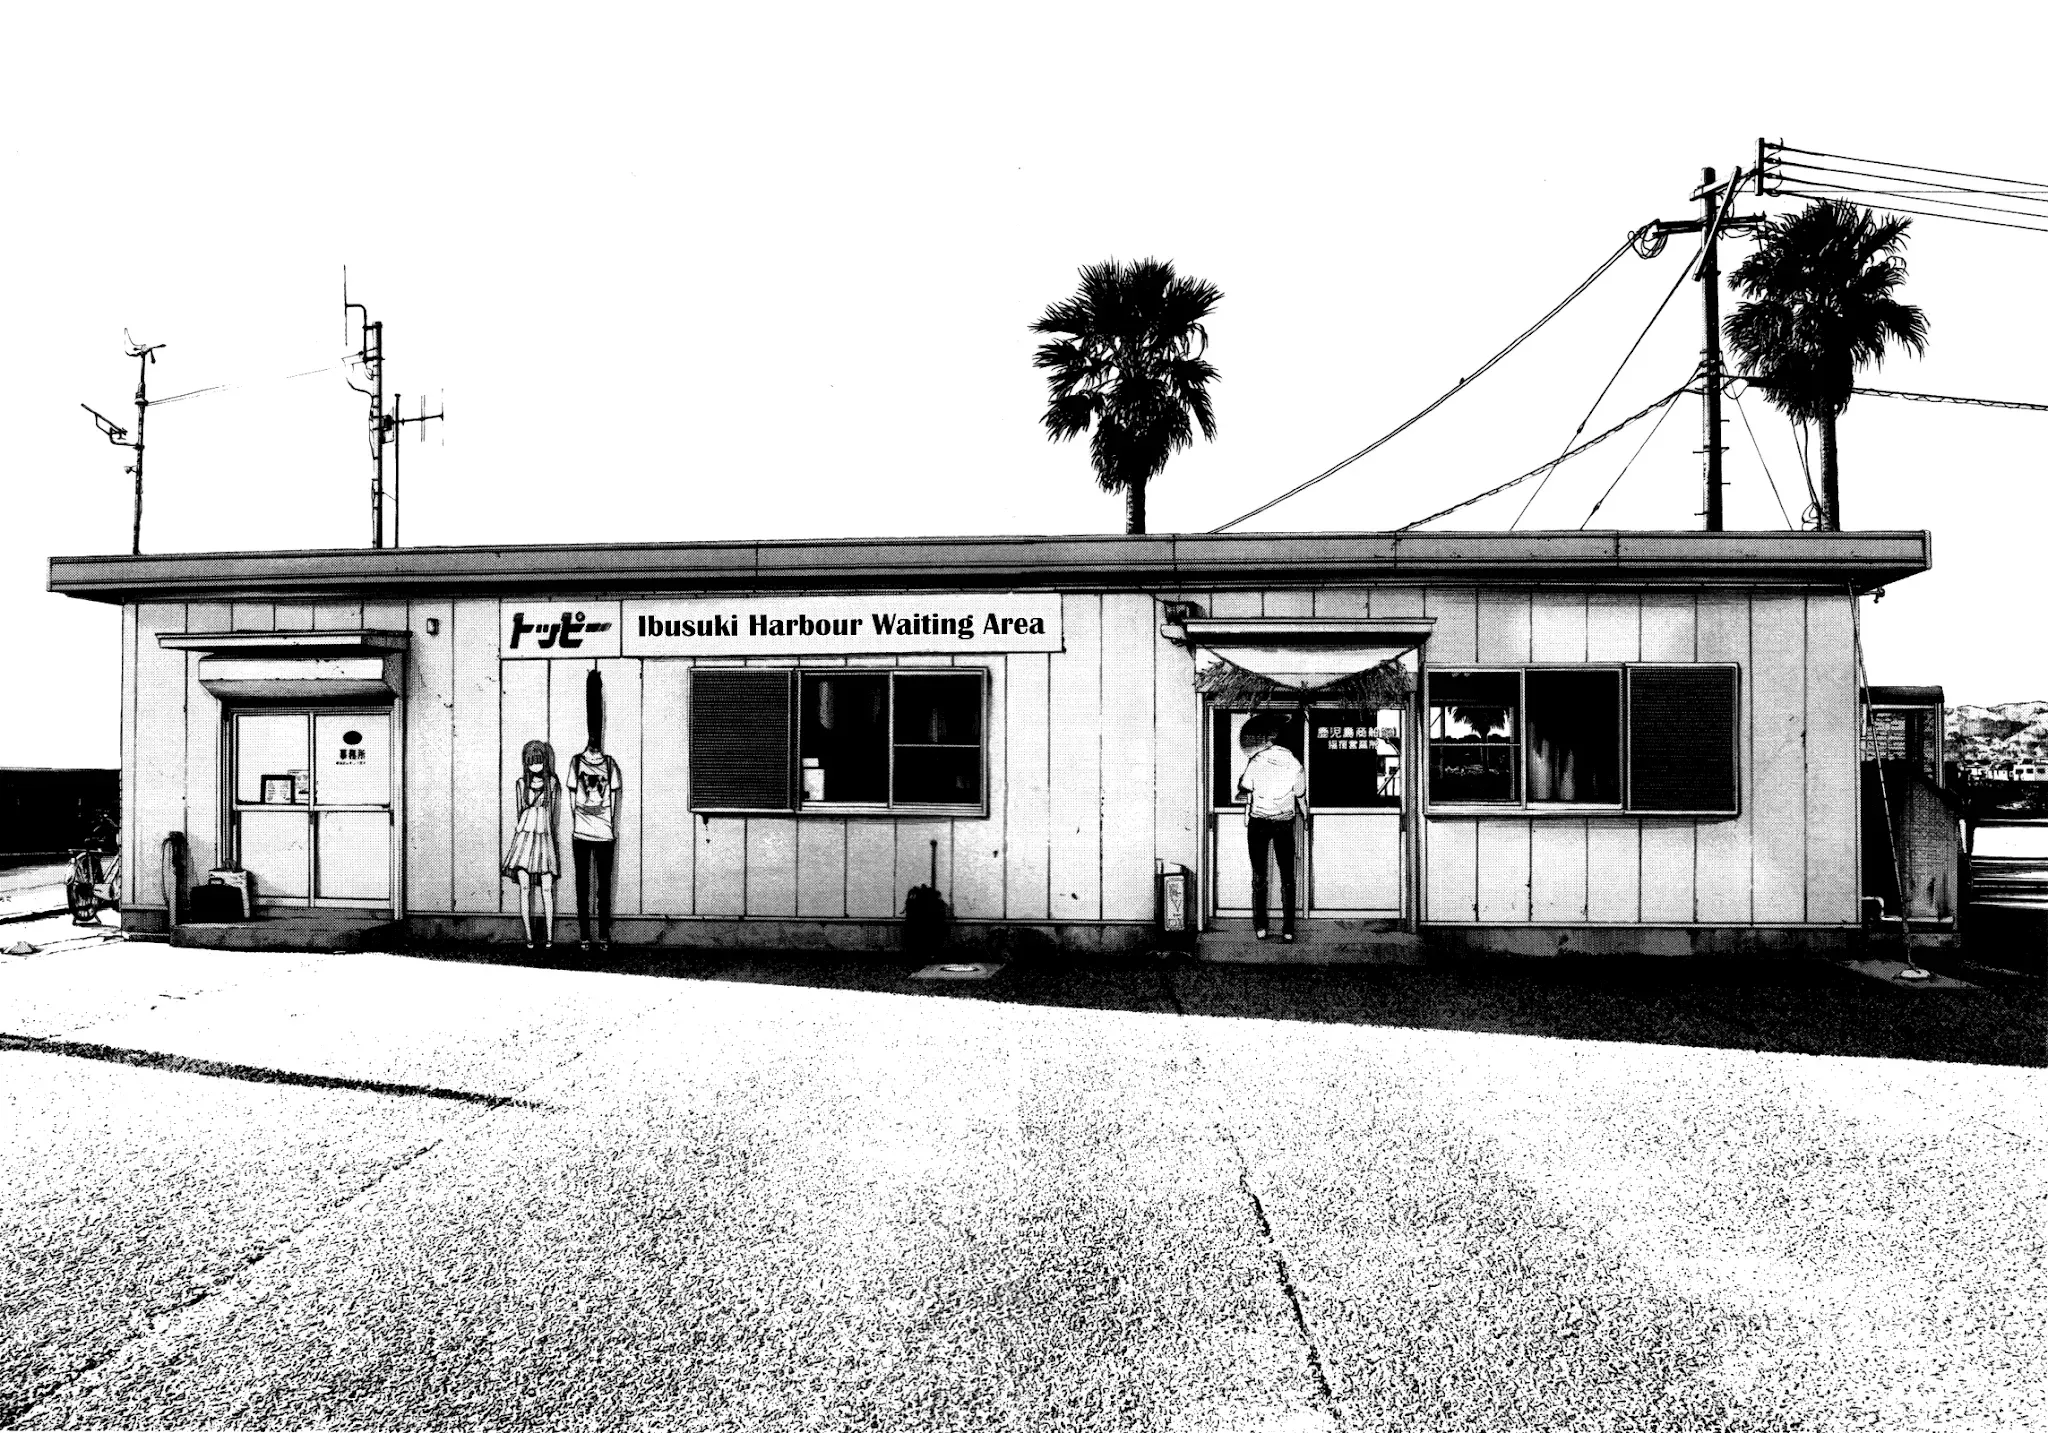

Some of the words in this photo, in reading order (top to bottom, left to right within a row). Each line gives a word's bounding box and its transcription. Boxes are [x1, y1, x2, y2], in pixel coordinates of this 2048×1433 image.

[509, 611, 612, 650] トッピー
[638, 614, 739, 637] Ibusuki
[749, 613, 864, 637] Harbour
[871, 612, 976, 640] Waiting
[982, 612, 1046, 636] Area
